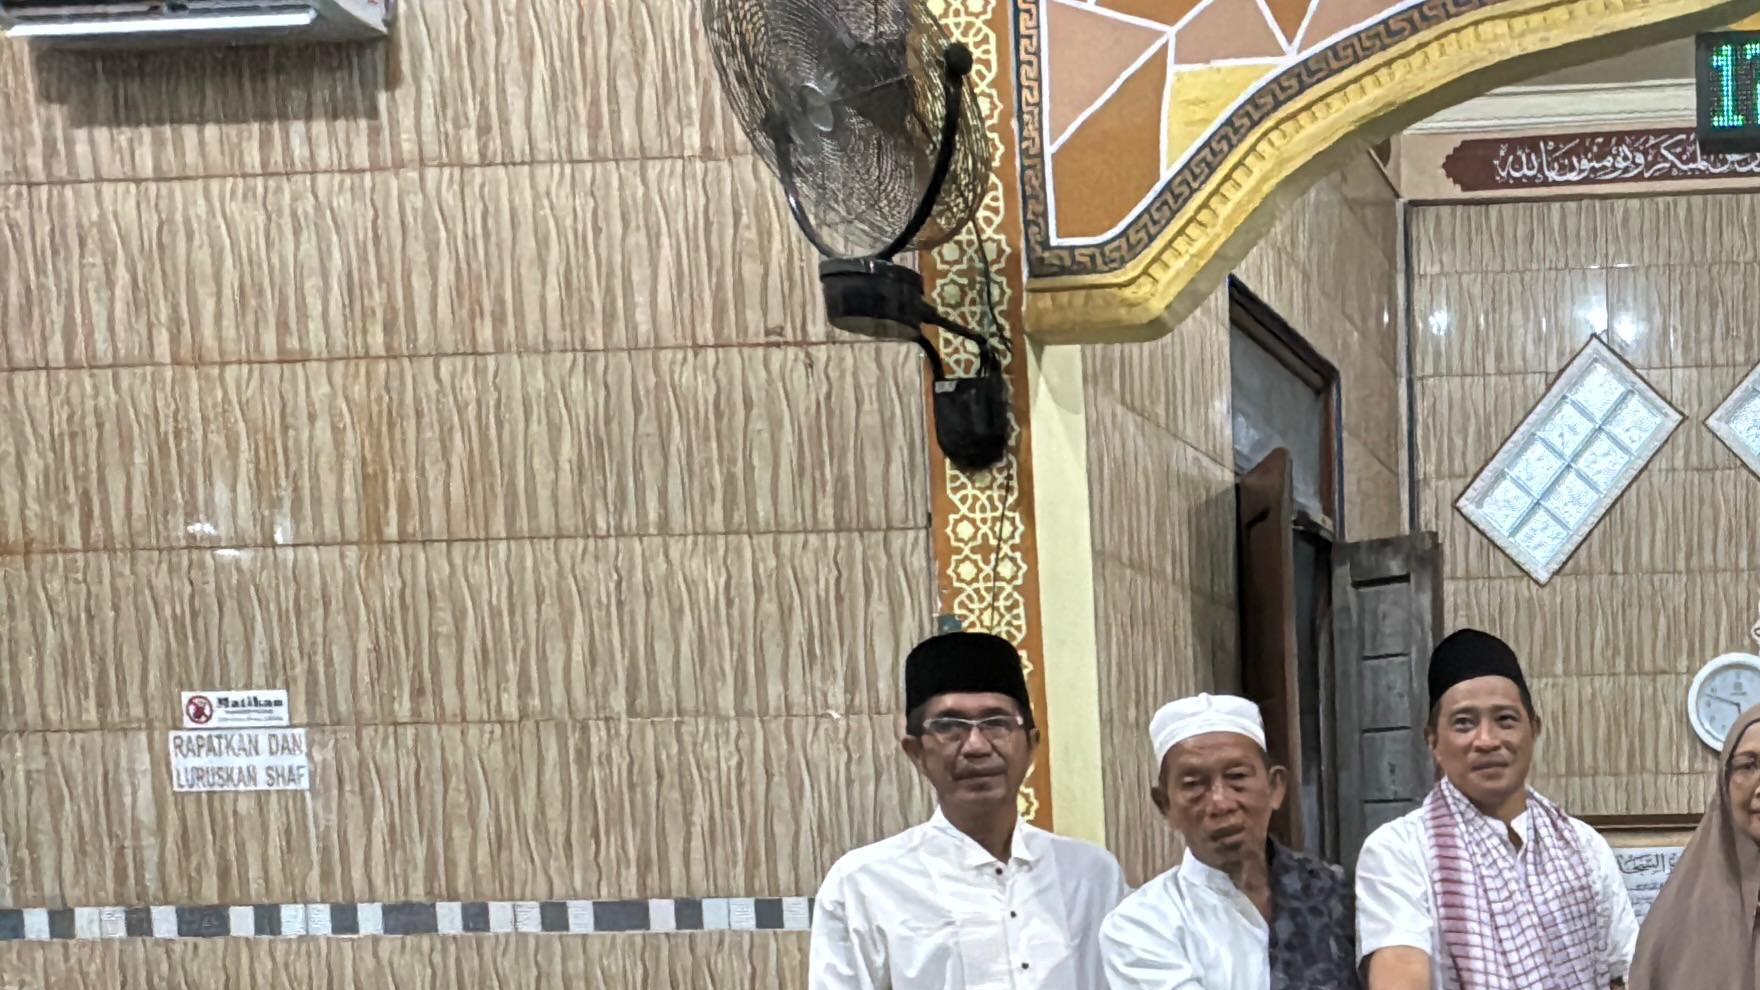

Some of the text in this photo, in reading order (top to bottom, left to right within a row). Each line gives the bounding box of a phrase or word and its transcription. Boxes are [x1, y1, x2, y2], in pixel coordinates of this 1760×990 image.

[173, 732, 303, 759] RAPATKAN DAN
[175, 763, 307, 789] LURUSKAN SHAF
